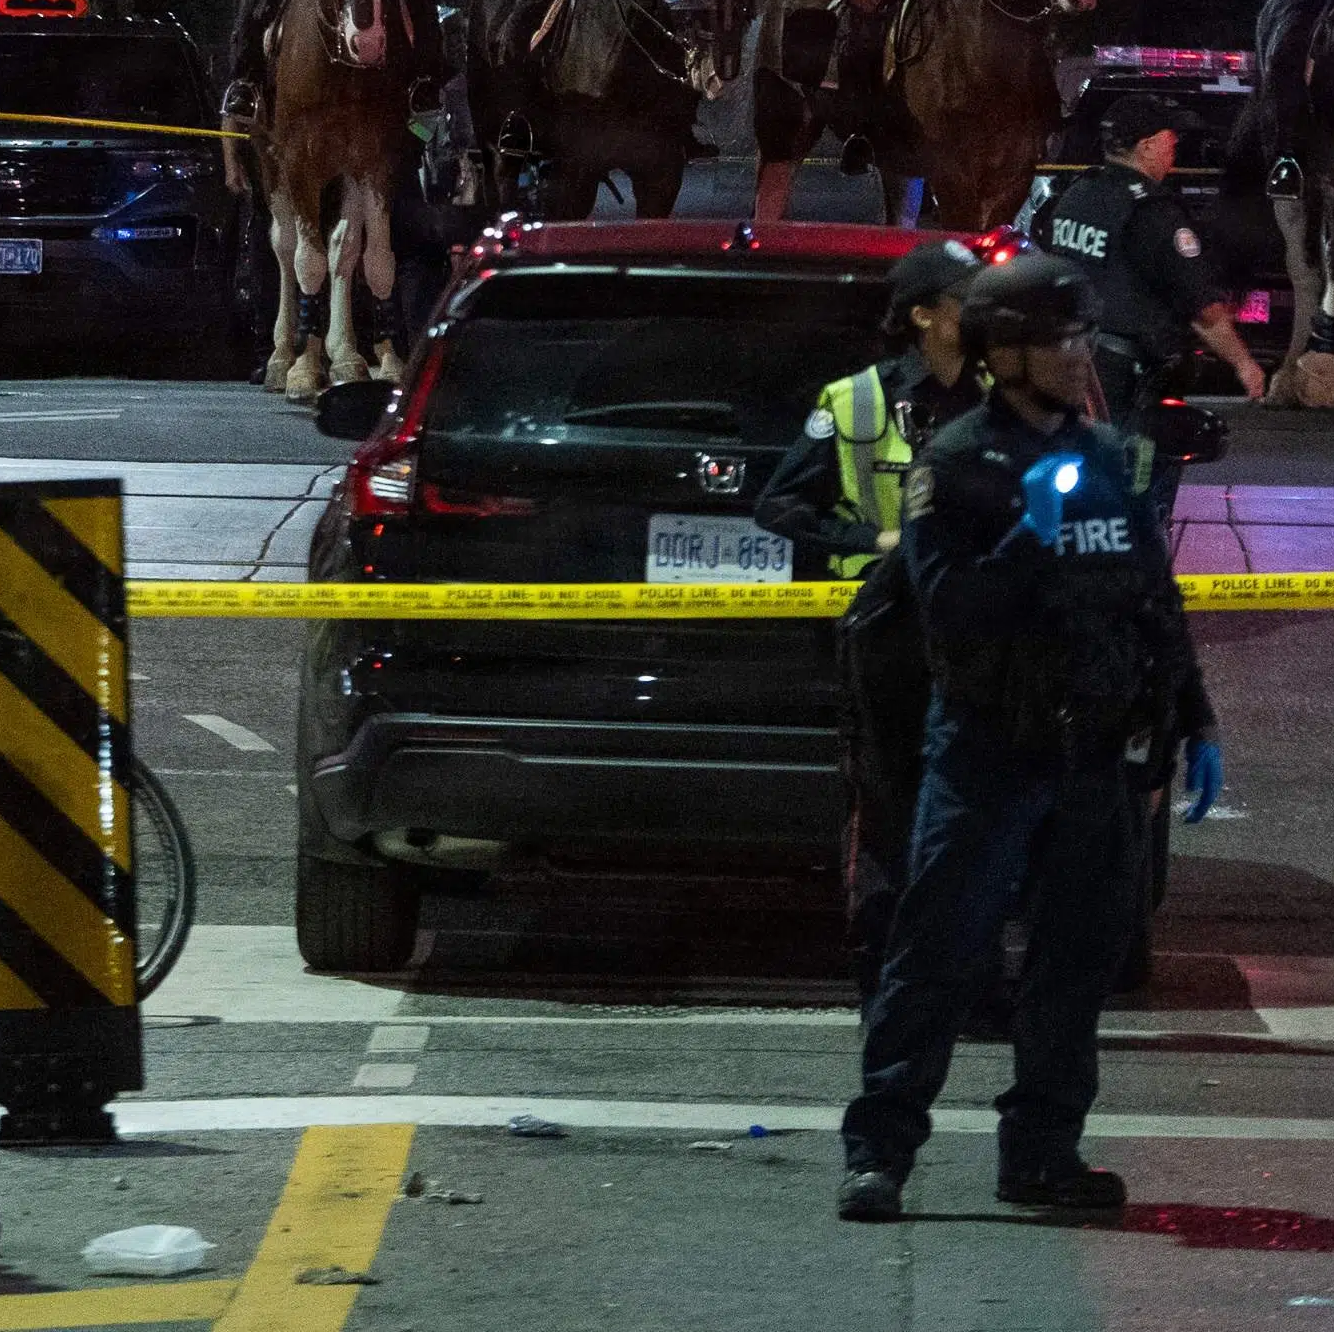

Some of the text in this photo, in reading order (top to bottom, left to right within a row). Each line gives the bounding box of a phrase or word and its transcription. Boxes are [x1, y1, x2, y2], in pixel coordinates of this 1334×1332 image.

[1052, 219, 1109, 258] POLICE
[1053, 517, 1133, 557] FIRE
[1212, 578, 1260, 590] POLICE
[1305, 577, 1320, 588] DO
[639, 587, 685, 599] POLICE
[830, 586, 857, 598] POL
